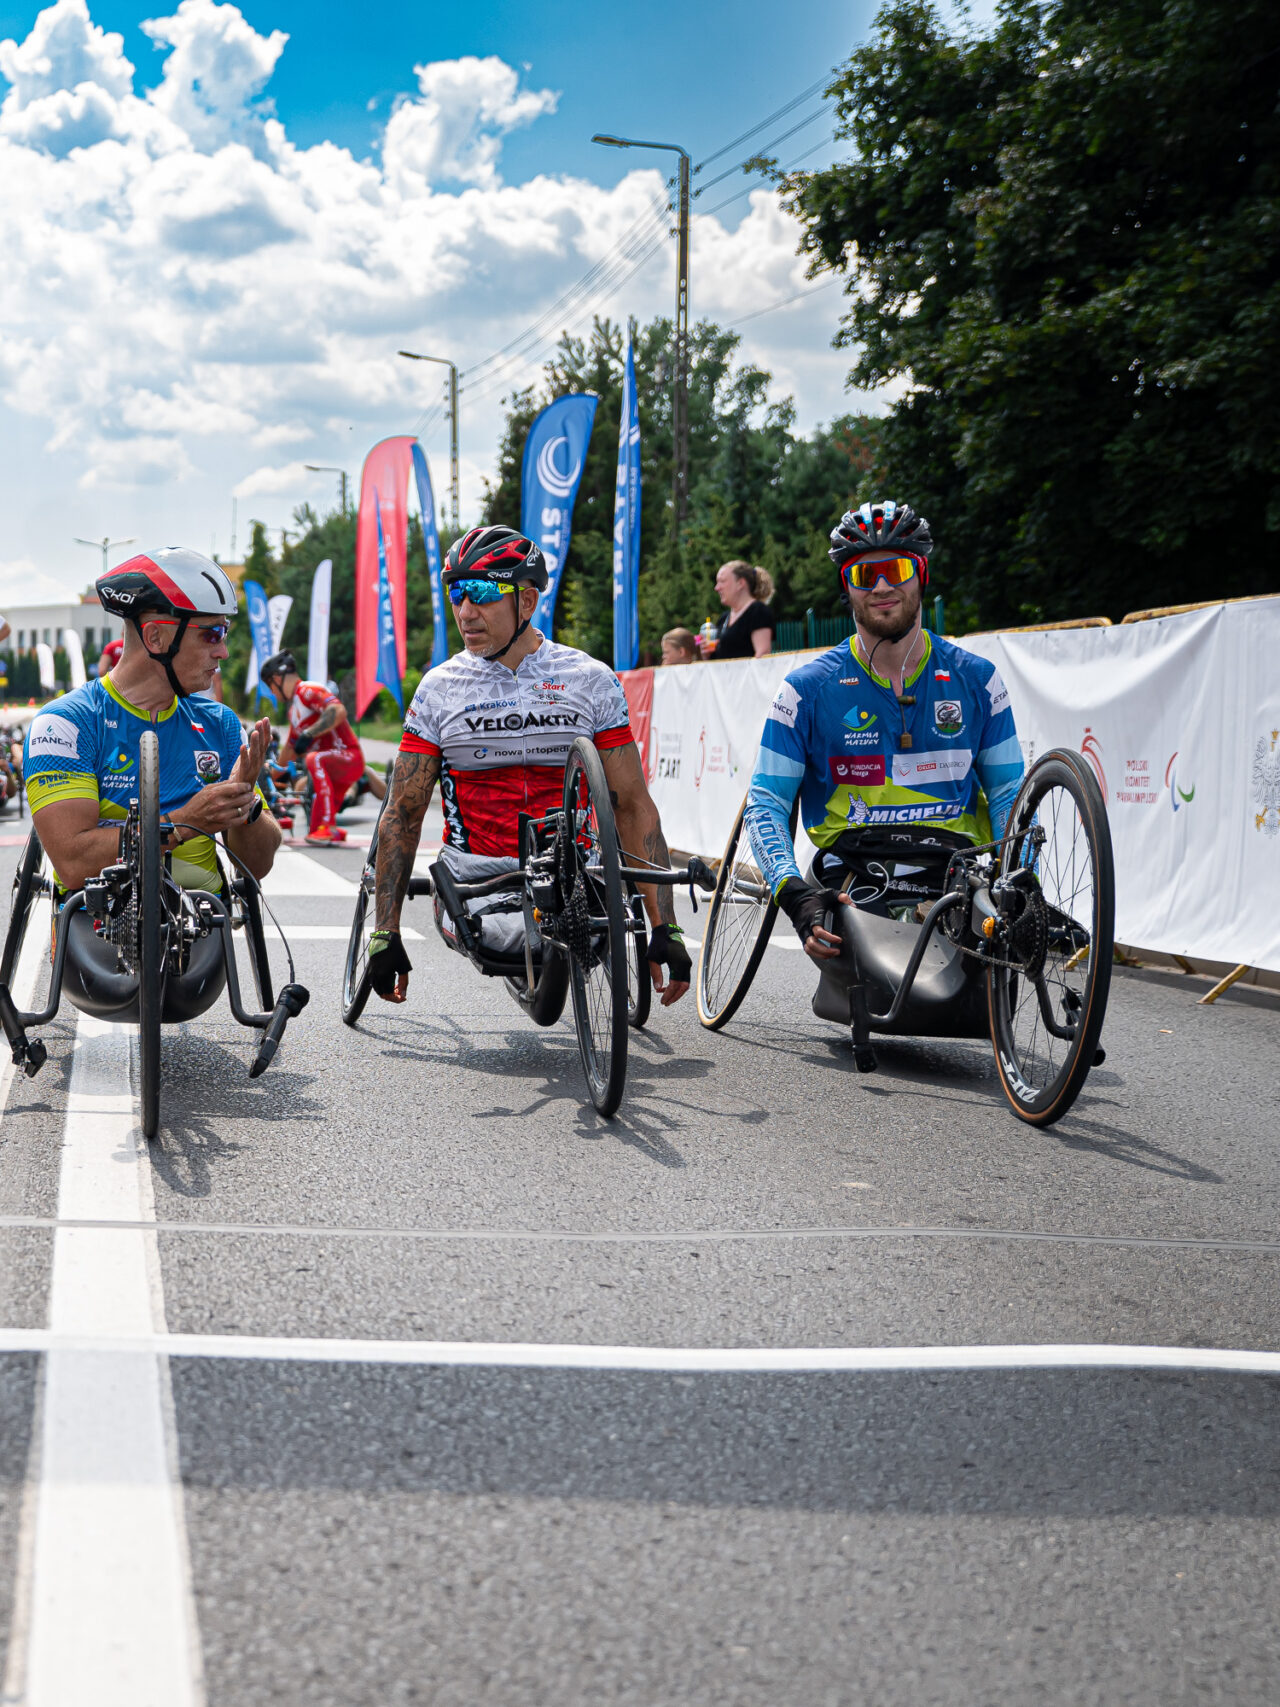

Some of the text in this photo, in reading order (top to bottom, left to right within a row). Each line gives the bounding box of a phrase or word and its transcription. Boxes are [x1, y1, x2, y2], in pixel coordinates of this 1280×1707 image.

[542, 682, 565, 691] Start
[480, 699, 517, 710] Kraków
[495, 745, 570, 757] nowa ortopedi
[850, 763, 881, 771] FUNDACJA
